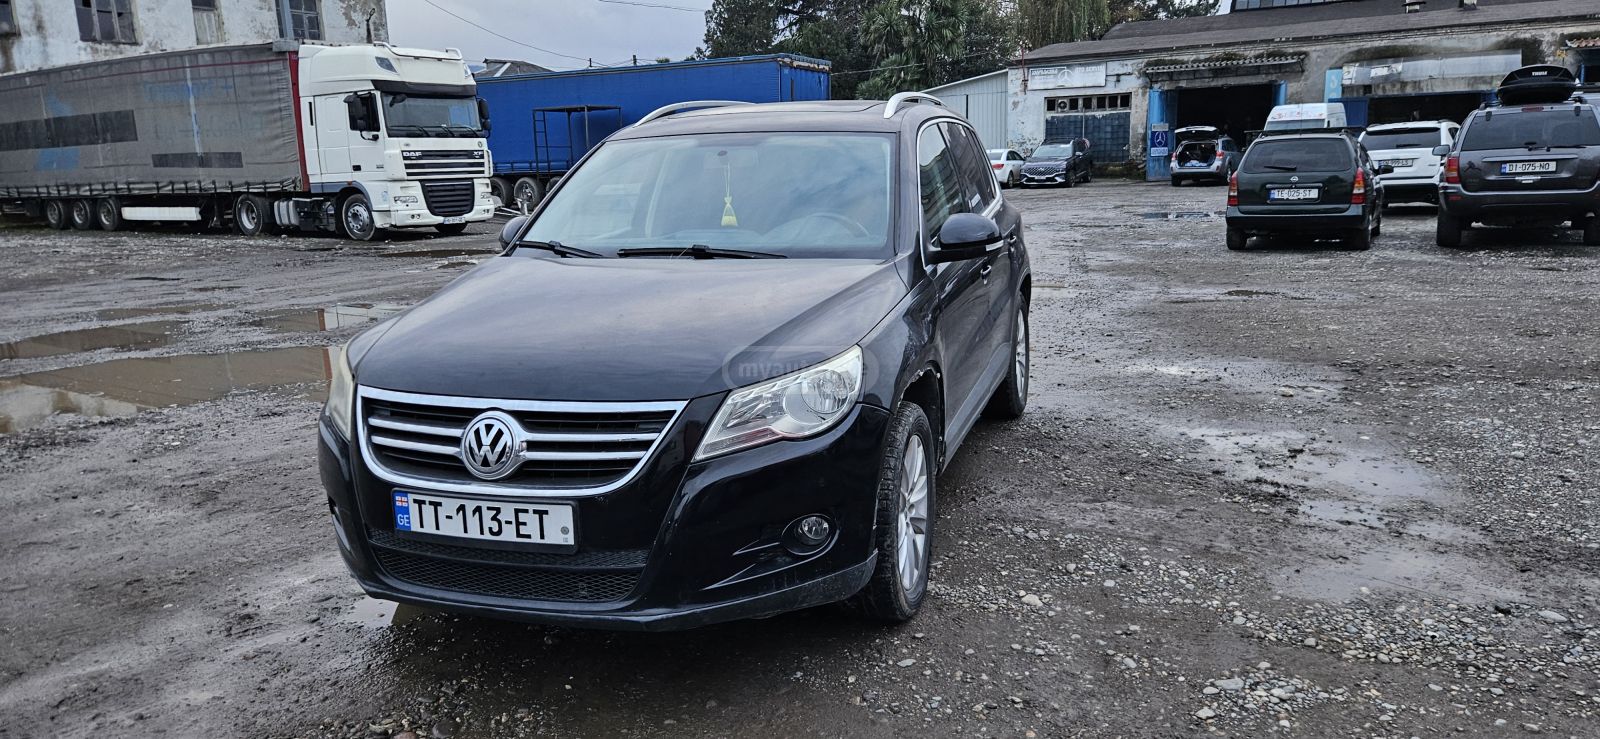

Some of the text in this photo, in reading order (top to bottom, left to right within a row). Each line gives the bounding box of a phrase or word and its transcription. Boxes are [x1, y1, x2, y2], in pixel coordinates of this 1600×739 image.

[1276, 189, 1312, 198] TE-025-ST
[466, 420, 511, 471] VW
[397, 514, 410, 527] GE
[412, 498, 549, 540] TT-113-ET
